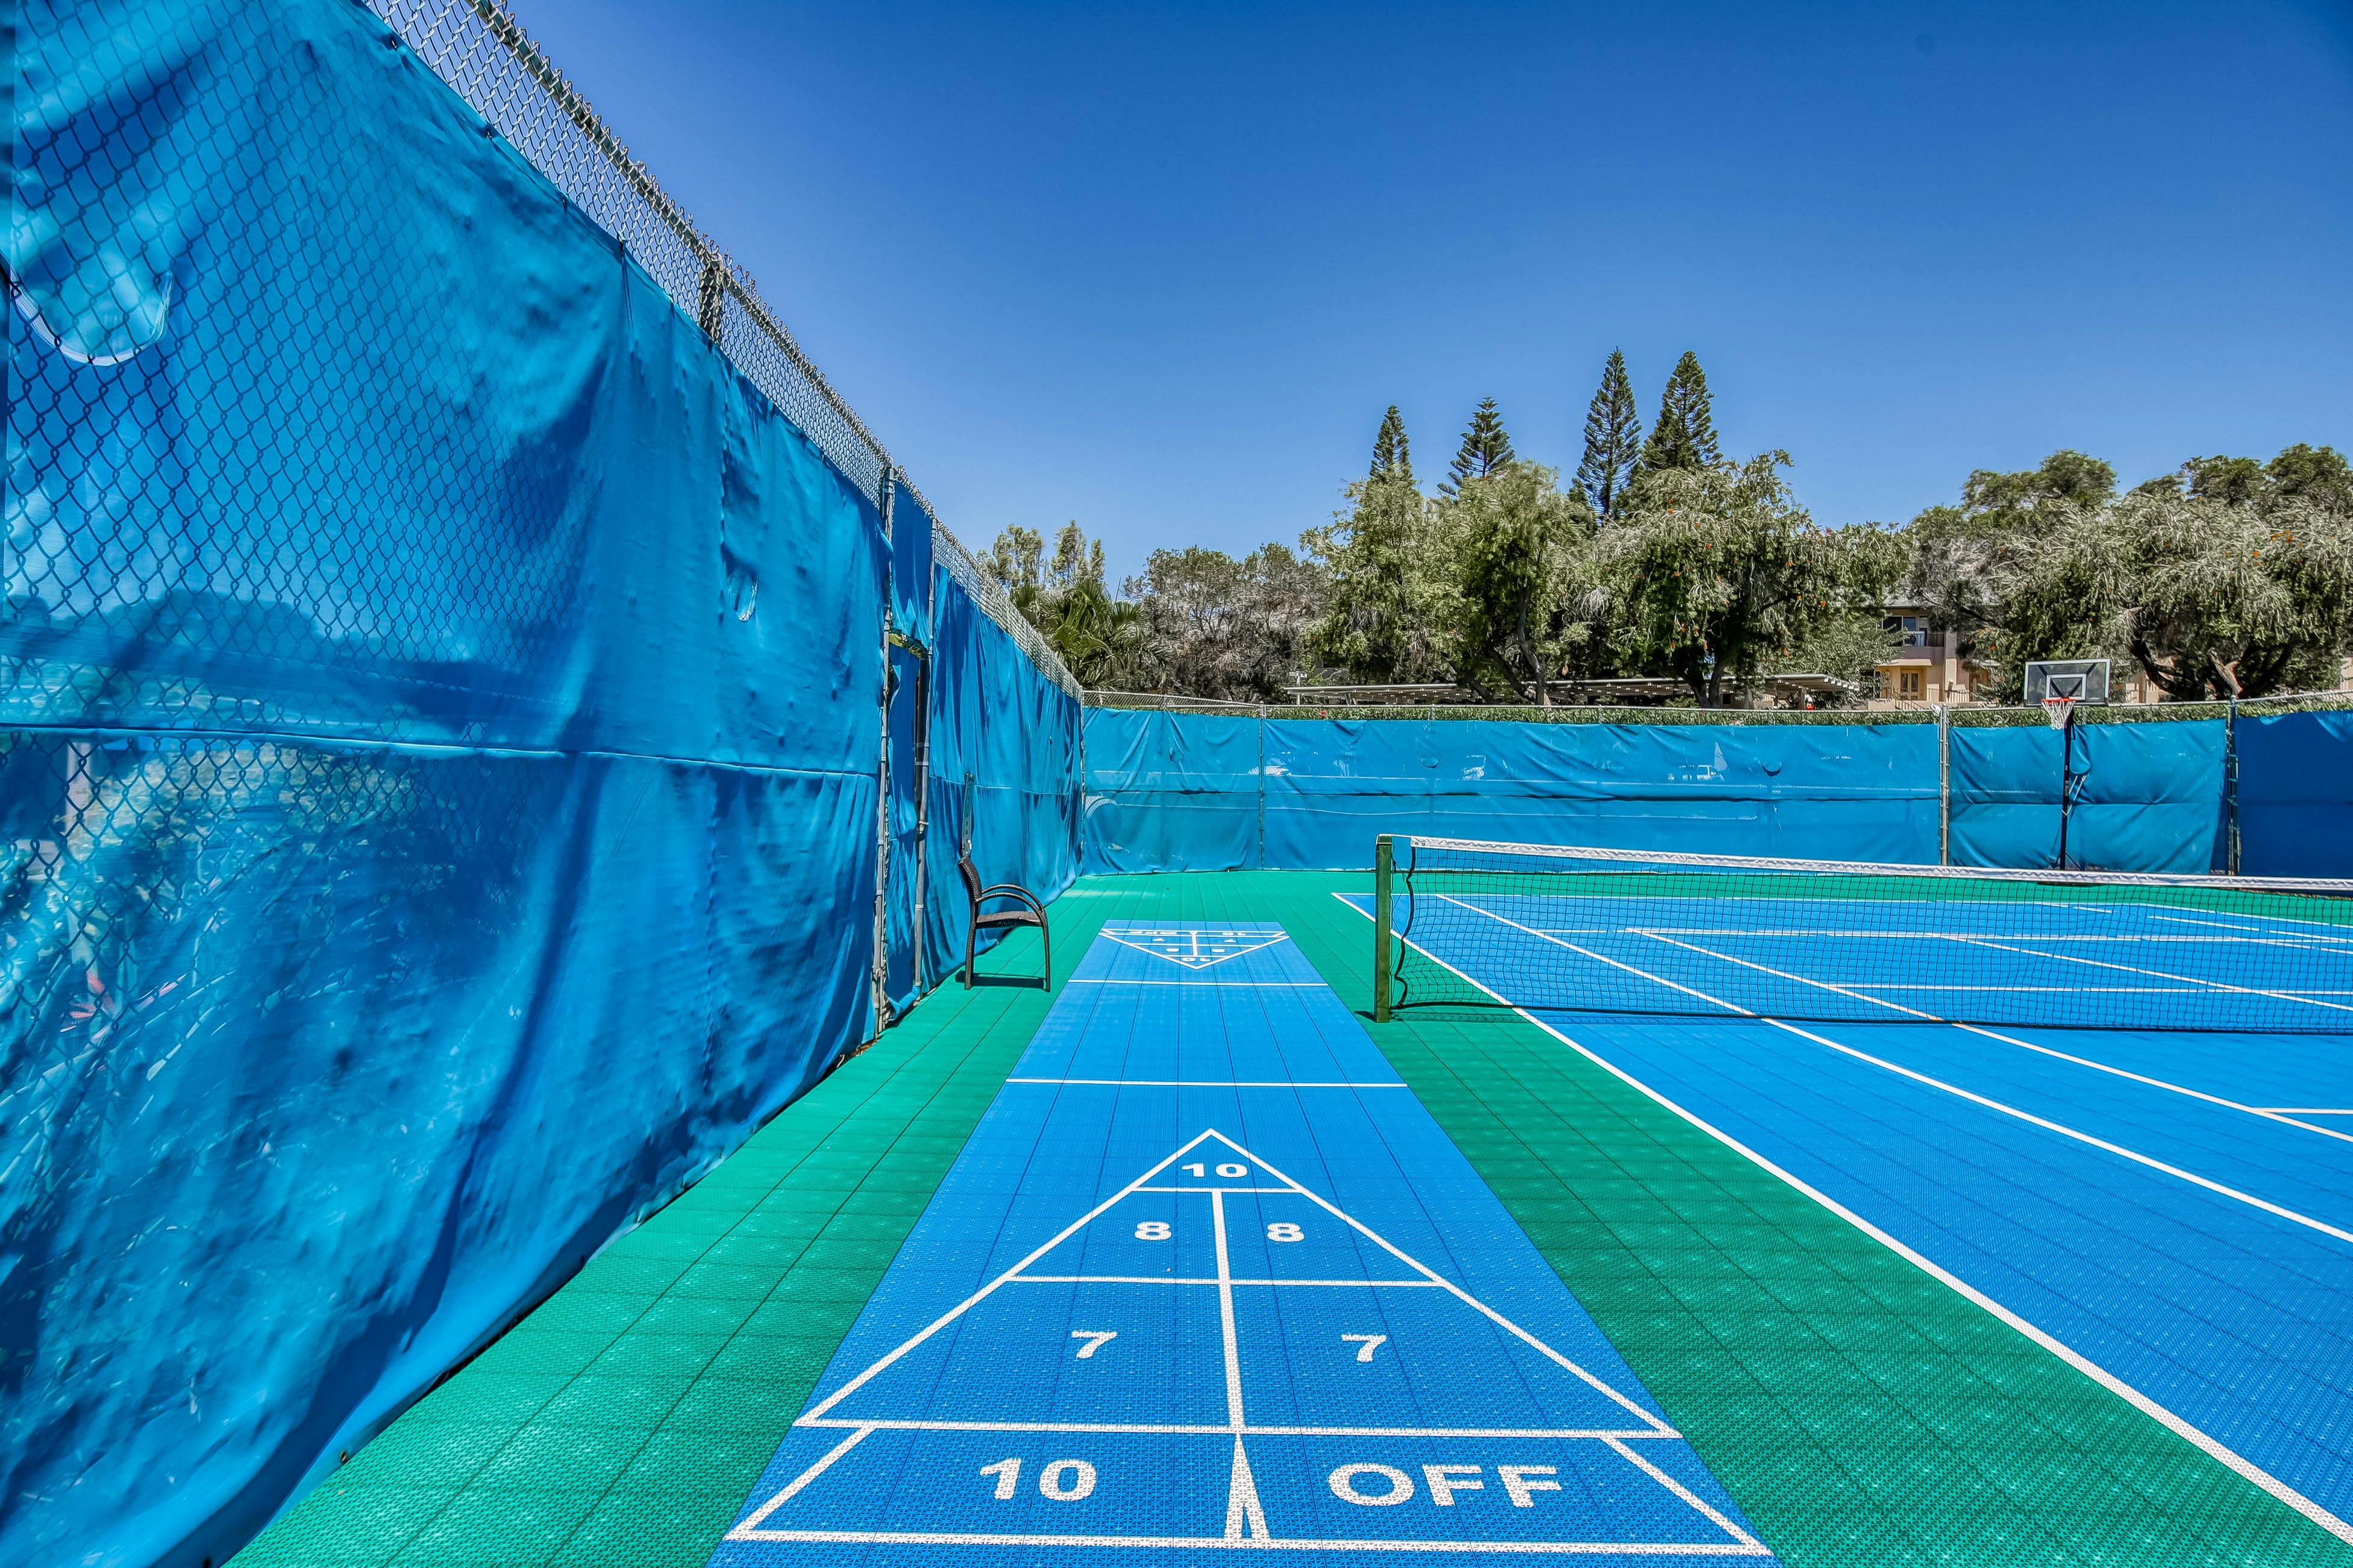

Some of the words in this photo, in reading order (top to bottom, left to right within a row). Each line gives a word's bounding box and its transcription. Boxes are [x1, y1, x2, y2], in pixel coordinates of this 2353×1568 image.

[1182, 1163, 1248, 1178] 10
[1135, 1222, 1172, 1240] 8
[1267, 1223, 1305, 1242] 8
[1072, 1331, 1117, 1359] 7
[1341, 1333, 1387, 1363] 7
[979, 1458, 1097, 1502] 10
[1328, 1463, 1562, 1507] OFF
